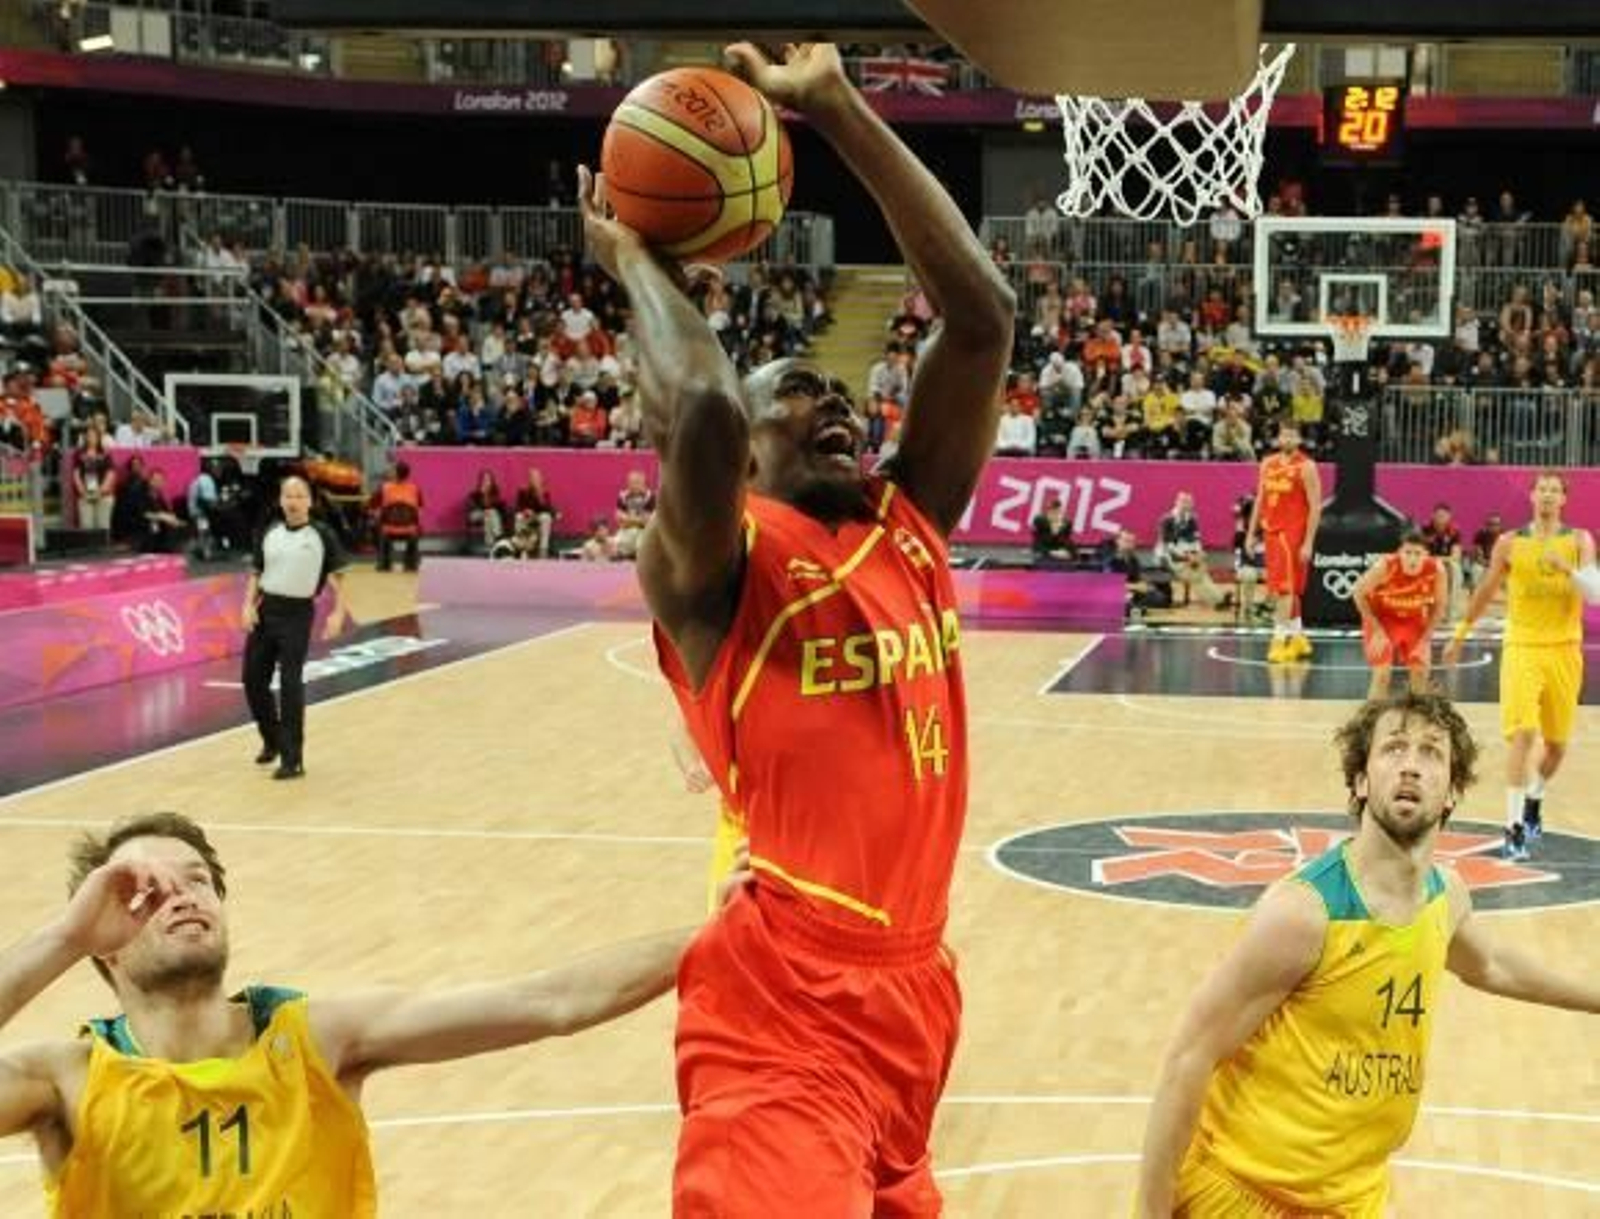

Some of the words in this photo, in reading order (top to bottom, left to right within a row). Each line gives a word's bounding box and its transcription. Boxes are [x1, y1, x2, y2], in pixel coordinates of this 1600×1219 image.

[454, 89, 521, 110] London
[525, 90, 568, 110] 2012
[1339, 110, 1388, 144] 20
[991, 475, 1132, 534] 2012
[906, 704, 949, 781] 14
[1376, 971, 1426, 1029] 14
[1325, 1051, 1420, 1098] AUSTRAL
[181, 1104, 249, 1178] 11
